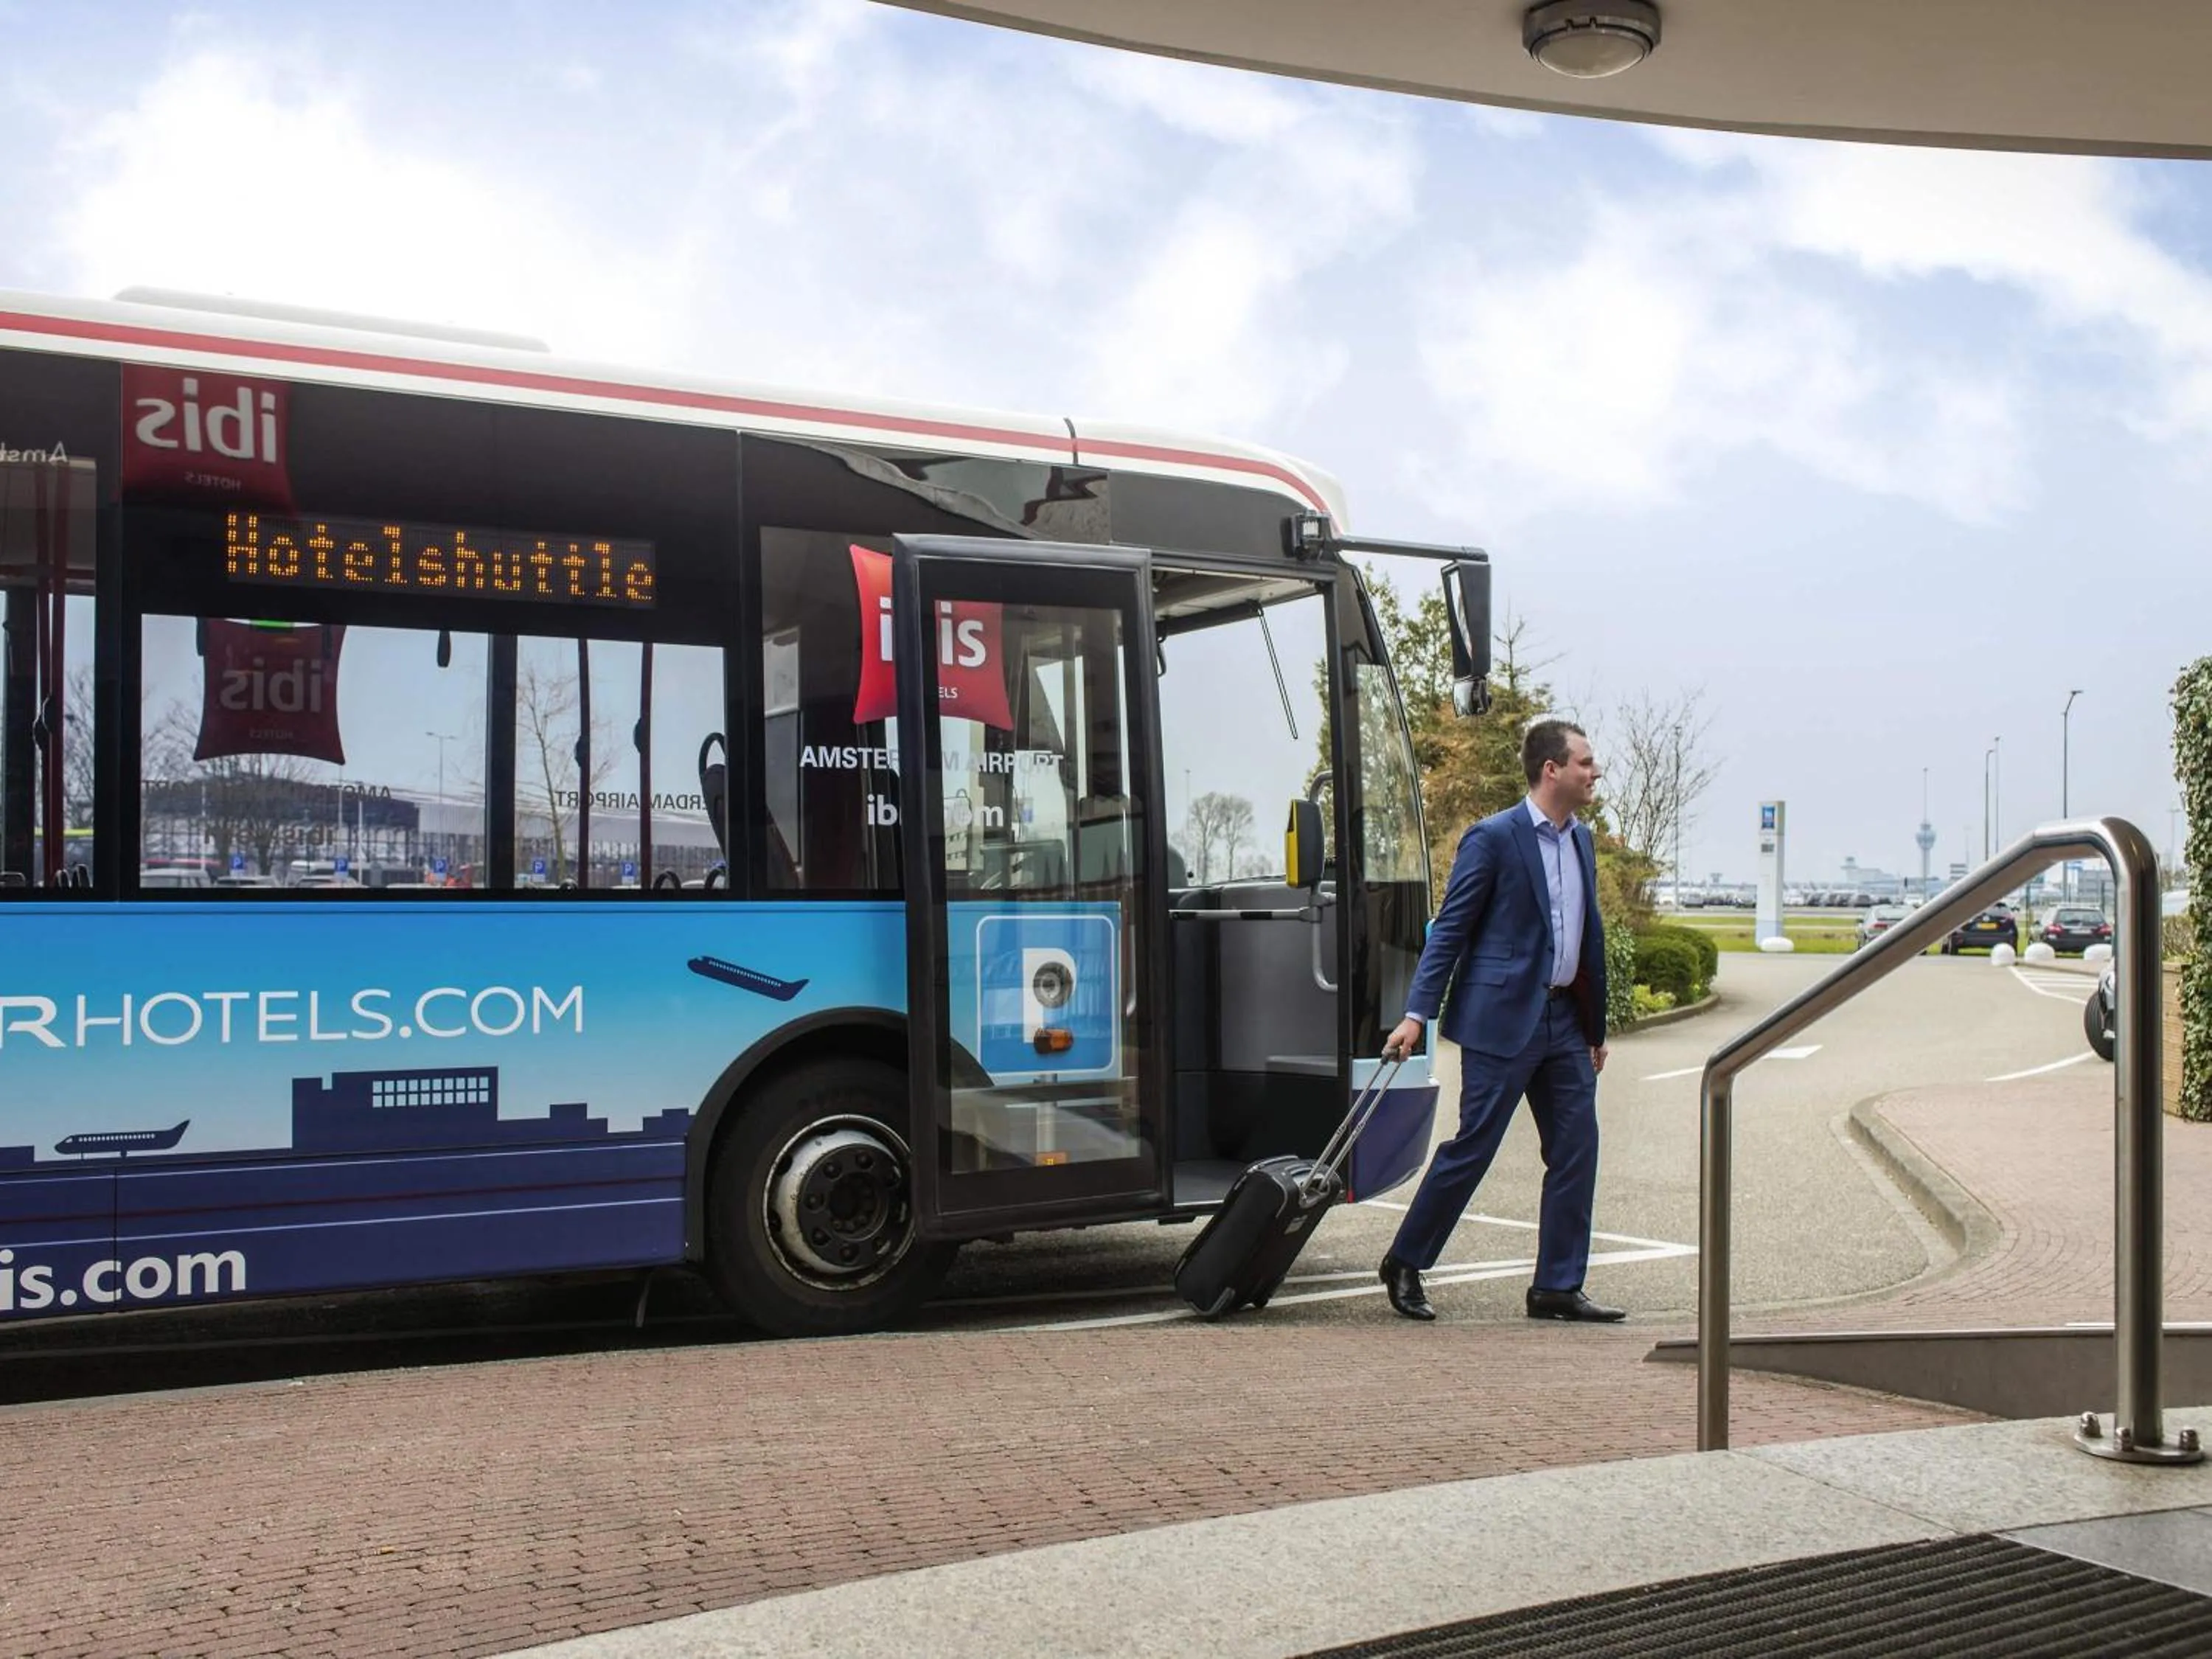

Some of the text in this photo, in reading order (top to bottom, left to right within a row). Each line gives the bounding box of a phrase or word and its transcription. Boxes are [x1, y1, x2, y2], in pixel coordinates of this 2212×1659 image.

[227, 513, 653, 599] Hotelshuttle
[879, 596, 987, 668] iis
[0, 1249, 246, 1311] is.com
